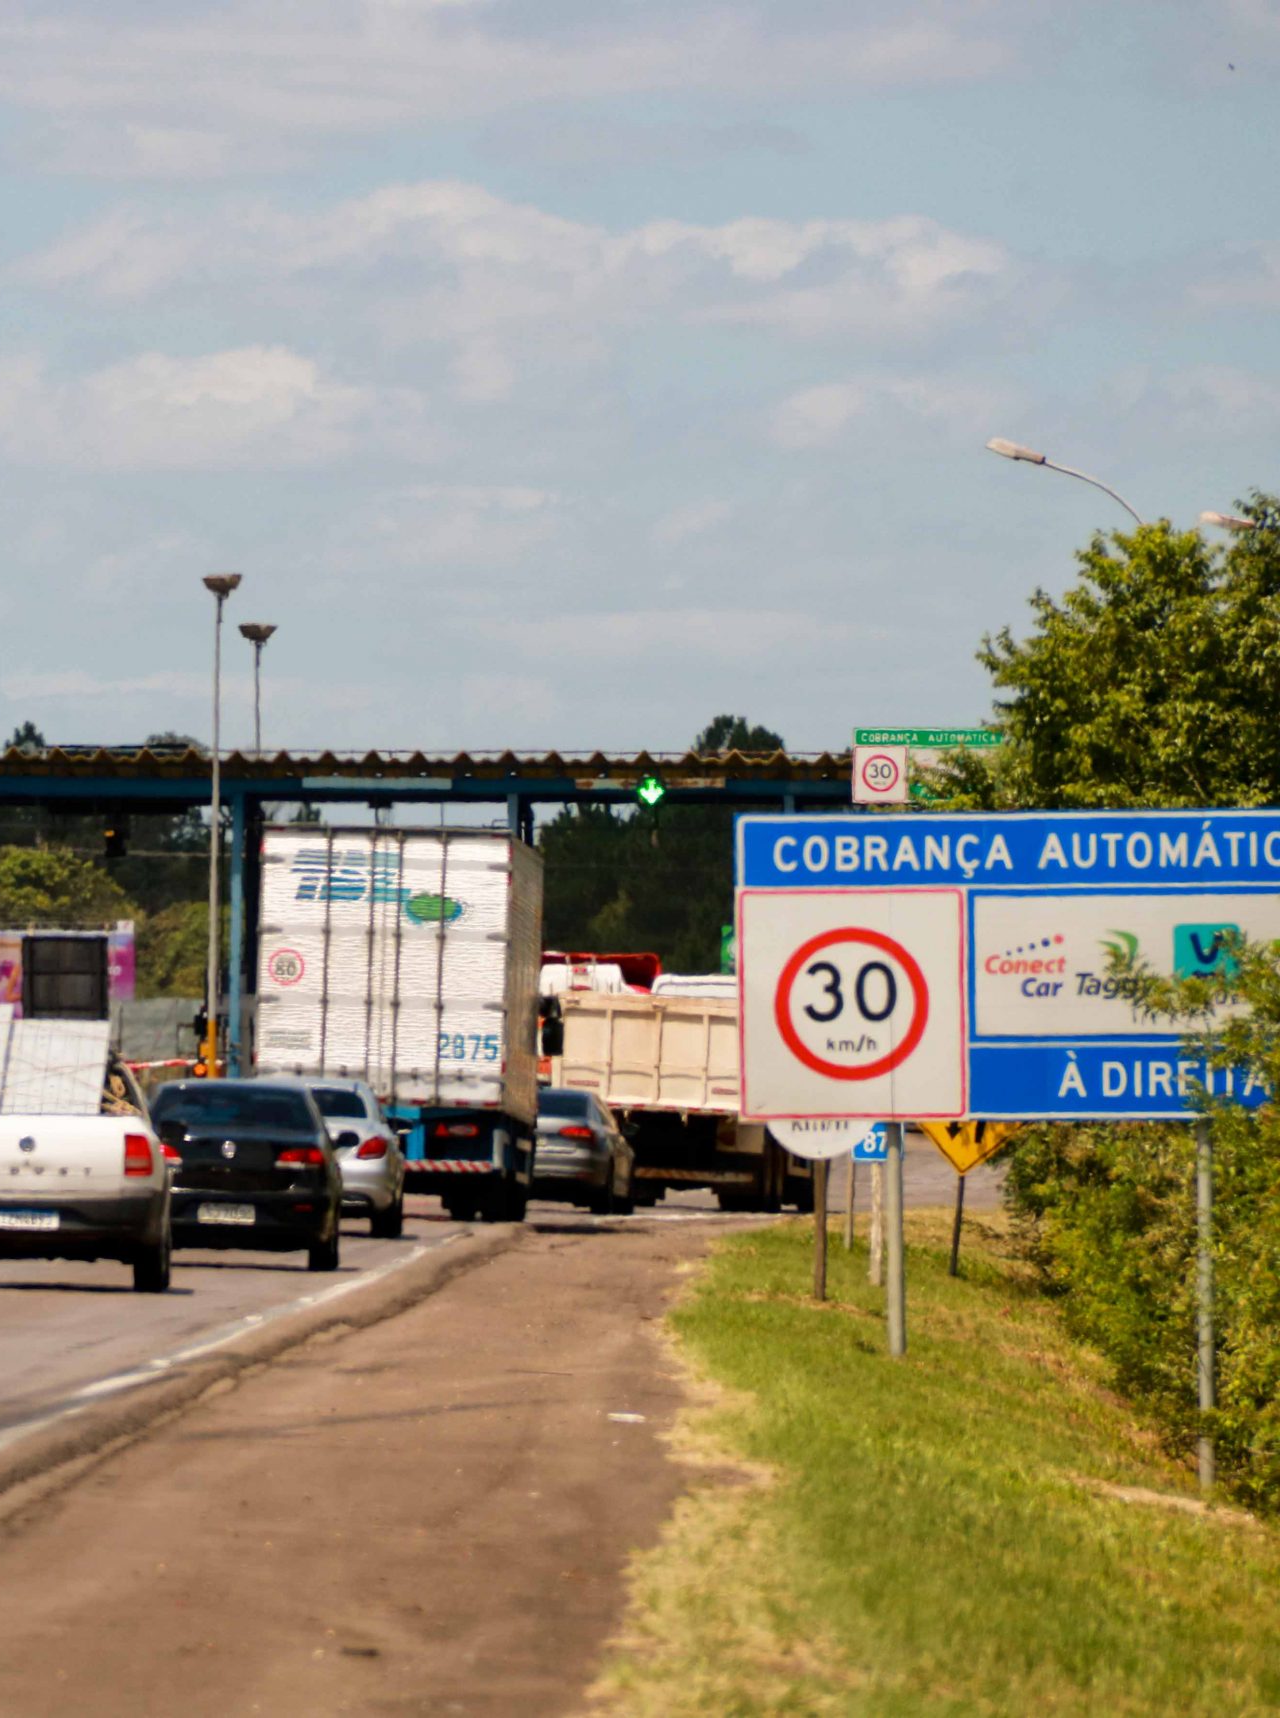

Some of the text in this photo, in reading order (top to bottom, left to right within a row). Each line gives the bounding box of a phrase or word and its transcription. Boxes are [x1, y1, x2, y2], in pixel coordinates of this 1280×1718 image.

[861, 732, 919, 744] COBRANÇA
[870, 763, 892, 779] 30
[773, 835, 1013, 878] COBRANÇA
[984, 954, 1066, 975] Conect
[803, 960, 897, 1022] 30
[1021, 977, 1063, 997] Car
[438, 1033, 498, 1060] 2875
[826, 1034, 877, 1052] km/h
[1057, 1050, 1087, 1097] À
